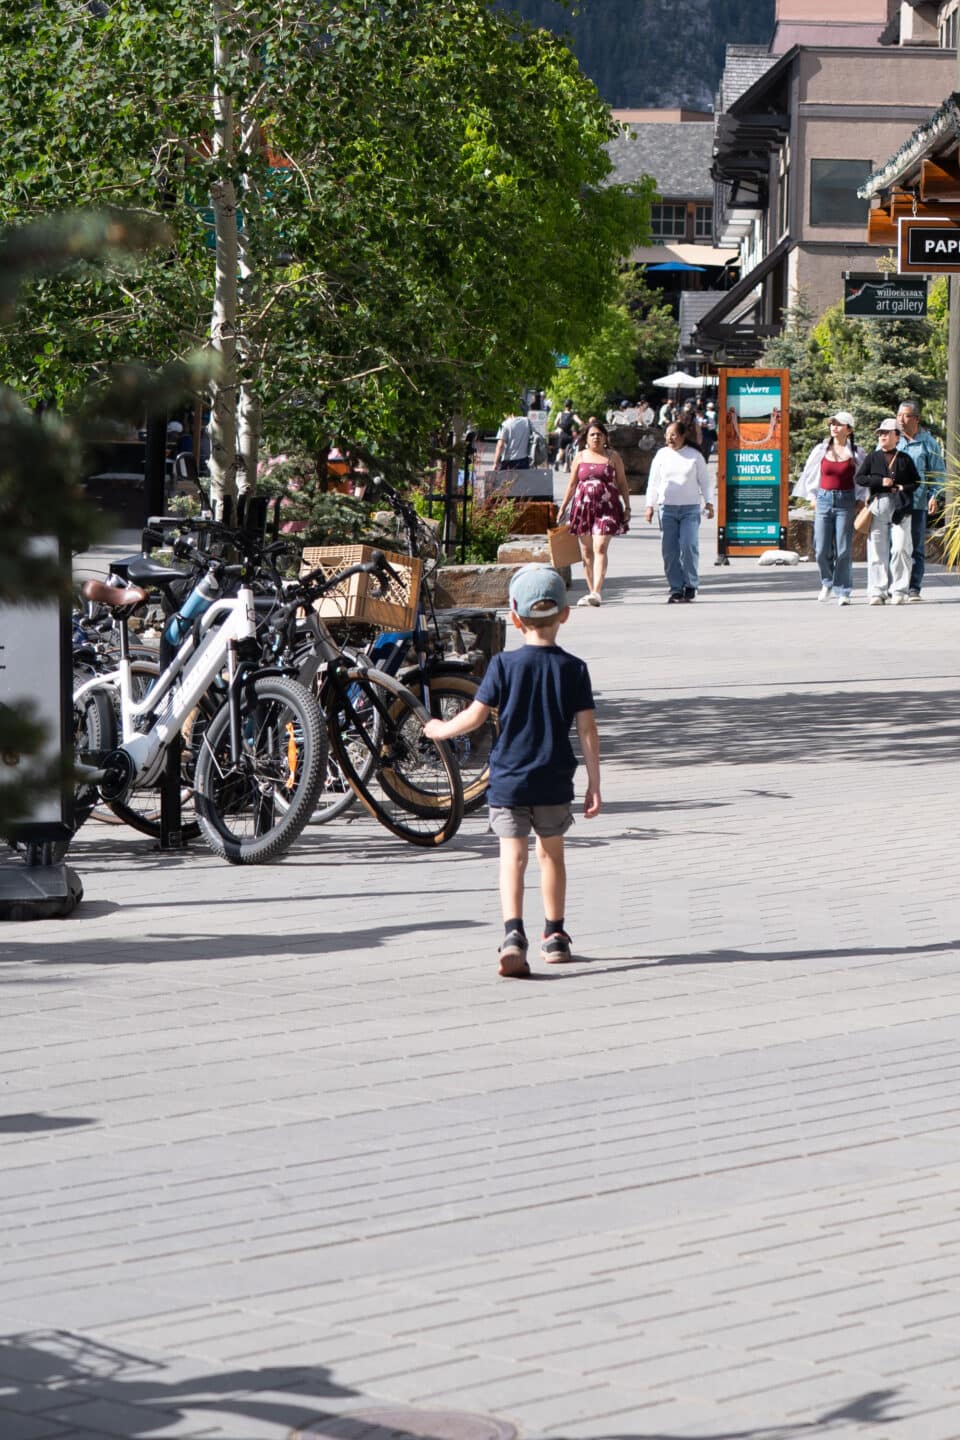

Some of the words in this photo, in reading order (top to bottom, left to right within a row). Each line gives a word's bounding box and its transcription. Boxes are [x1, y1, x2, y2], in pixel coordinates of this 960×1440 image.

[876, 300, 889, 311] art
[891, 298, 924, 314] gallery
[734, 453, 759, 462] THICK
[762, 453, 773, 462] AS
[736, 465, 771, 474] THIEVES
